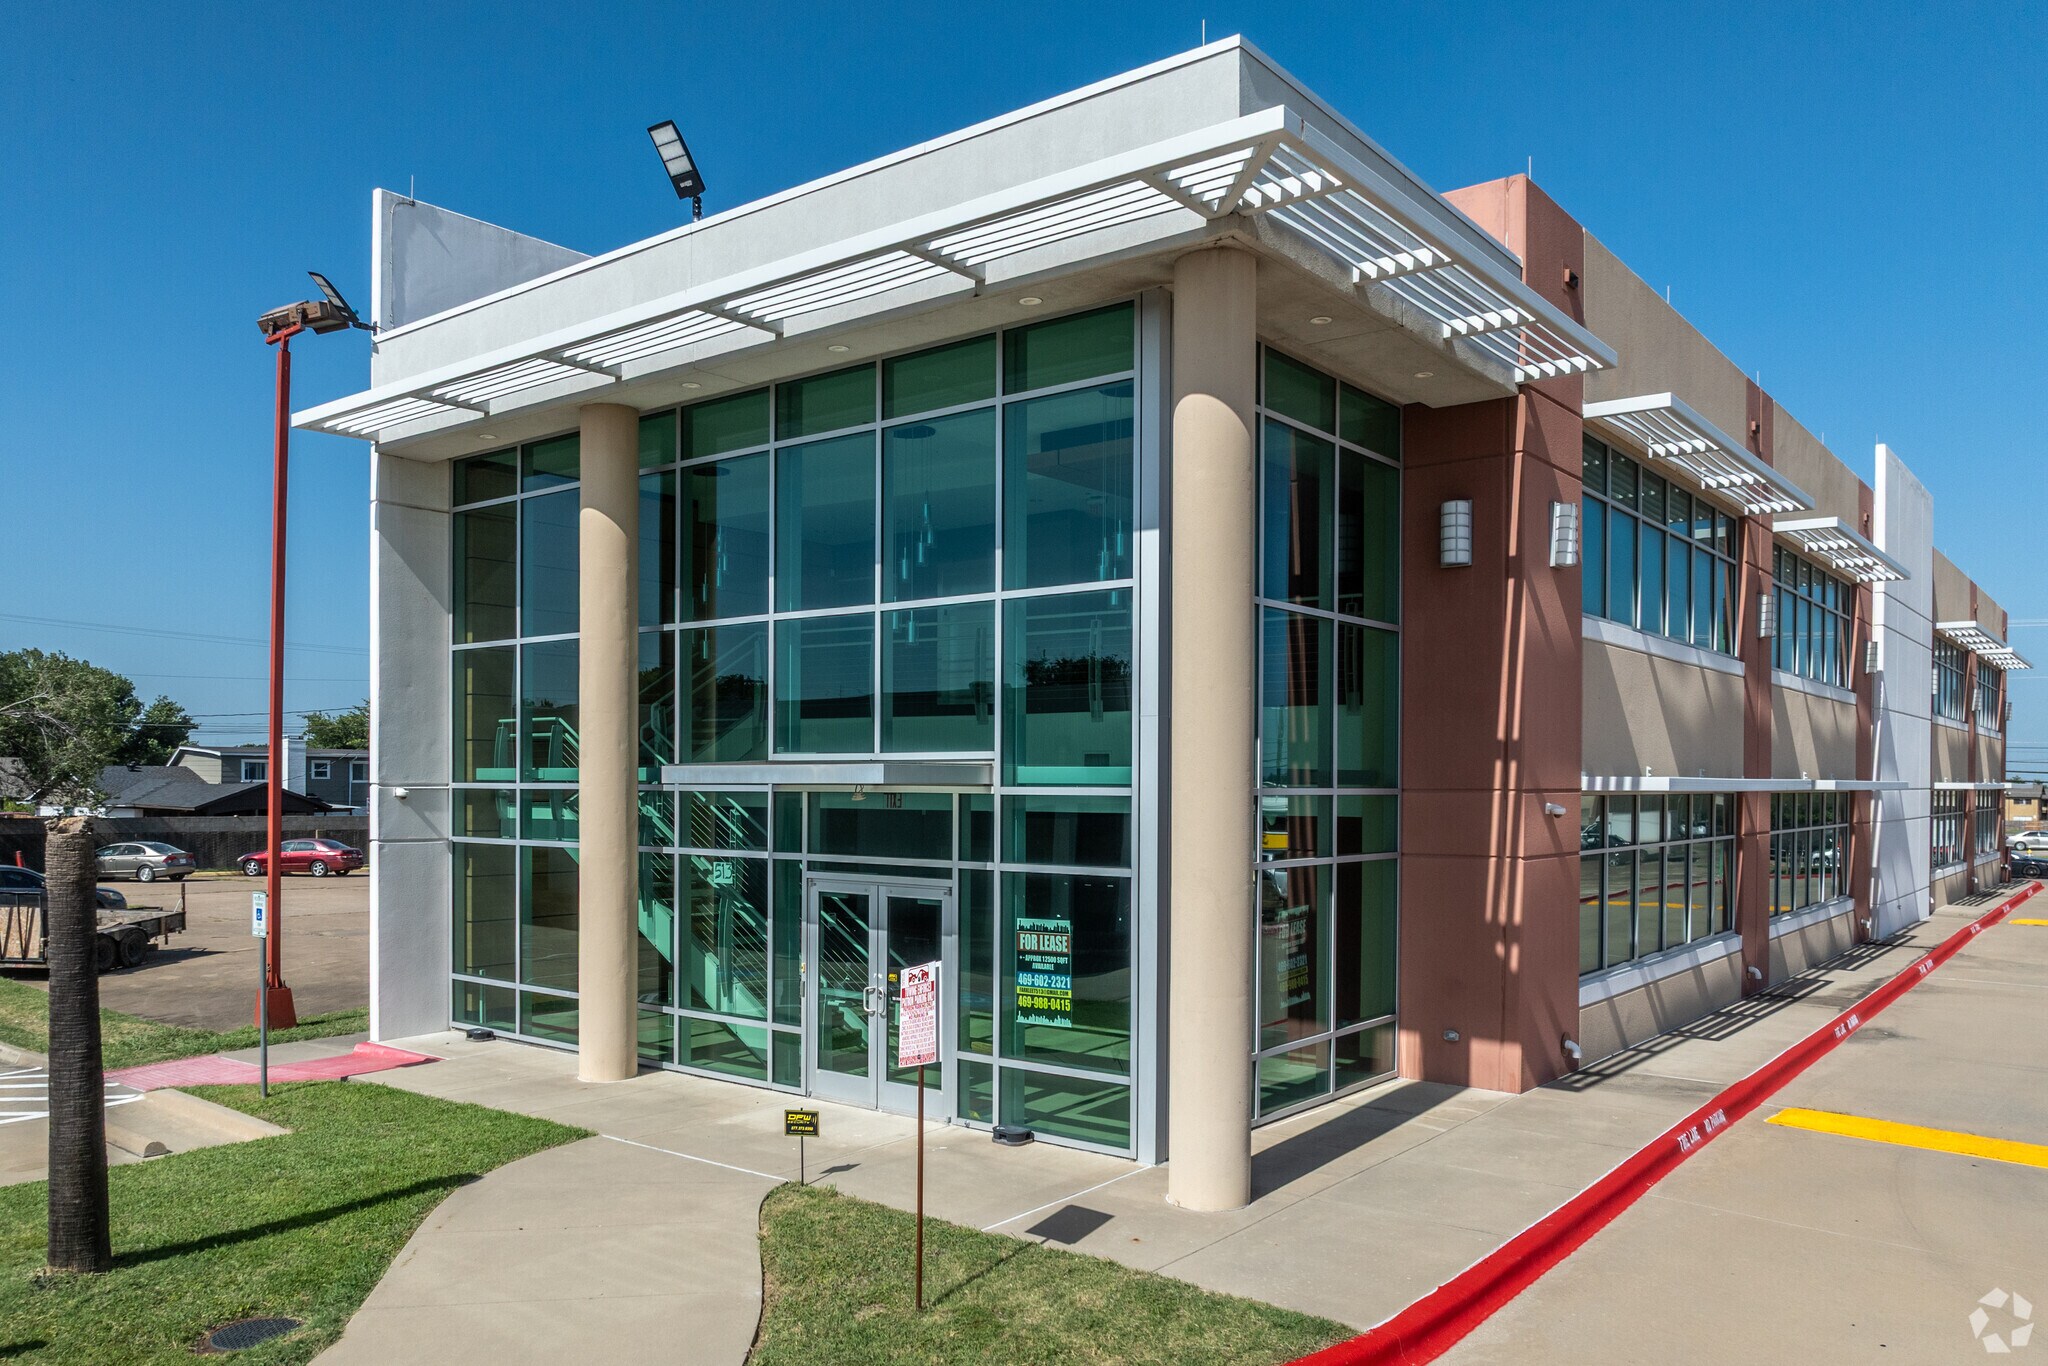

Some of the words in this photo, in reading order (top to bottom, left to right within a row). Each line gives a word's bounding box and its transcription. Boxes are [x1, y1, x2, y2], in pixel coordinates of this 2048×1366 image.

[714, 863, 733, 880] 513
[1290, 919, 1307, 937] LEASE
[1020, 934, 1038, 950] FOR
[1040, 935, 1068, 952] LEASE
[1057, 957, 1068, 965] SQFT
[1018, 973, 1070, 989] 469-602-2321
[1018, 995, 1071, 1011] 469-988-0415
